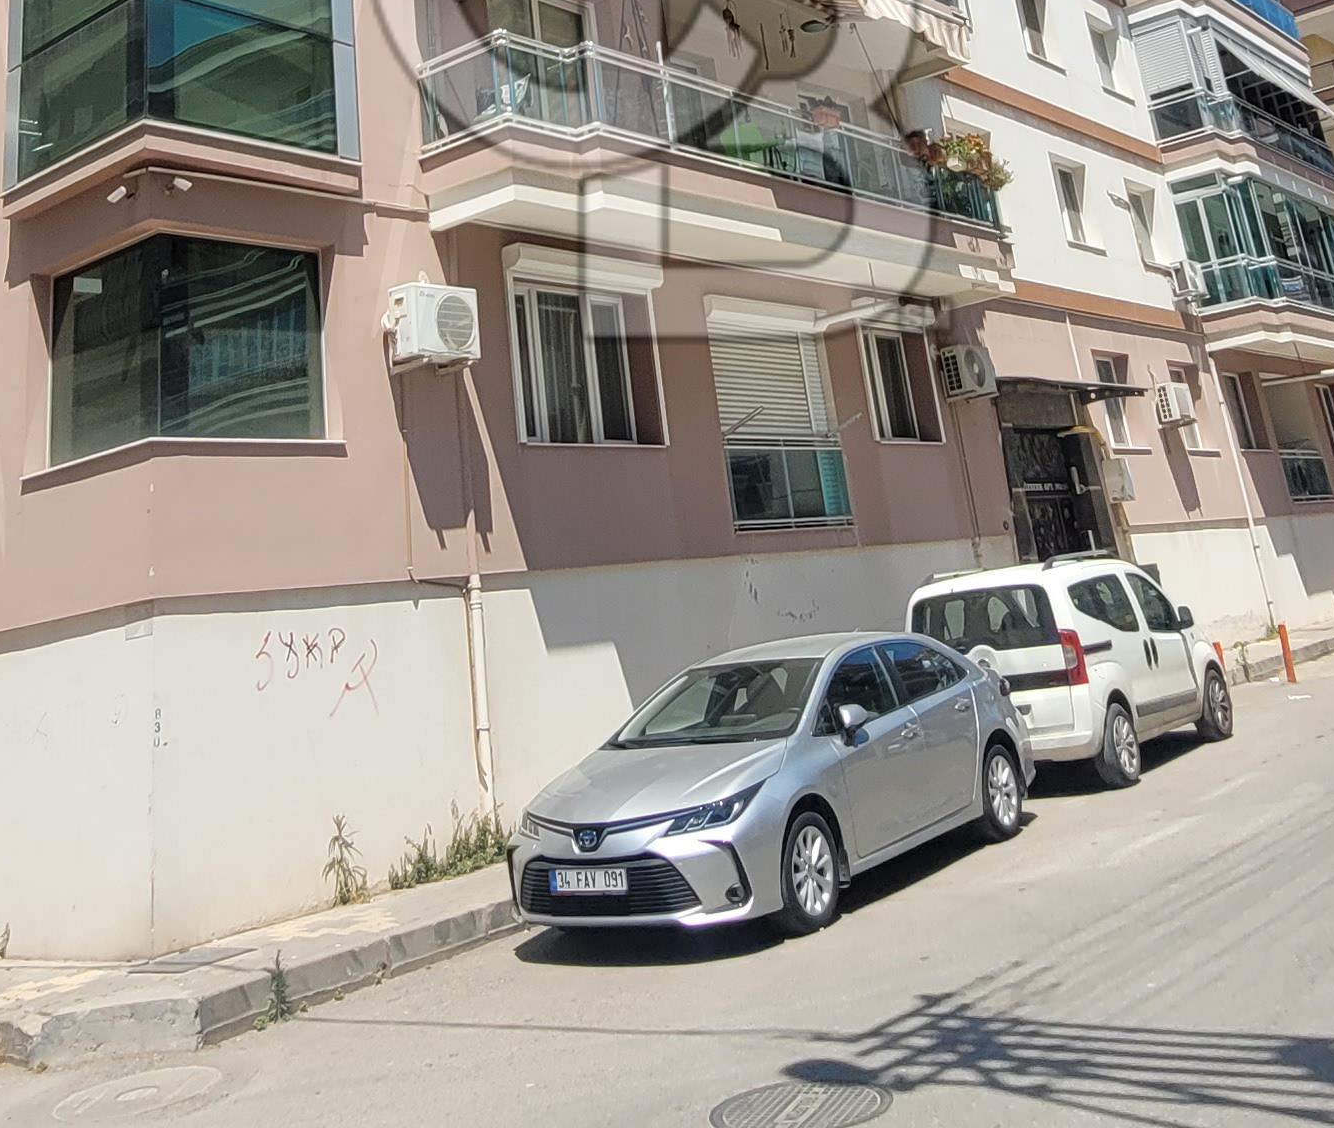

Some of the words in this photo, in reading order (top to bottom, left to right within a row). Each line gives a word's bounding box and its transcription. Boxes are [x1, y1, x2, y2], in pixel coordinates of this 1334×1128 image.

[557, 871, 571, 889] 34
[576, 871, 596, 889] FAY
[603, 870, 624, 889] 091
